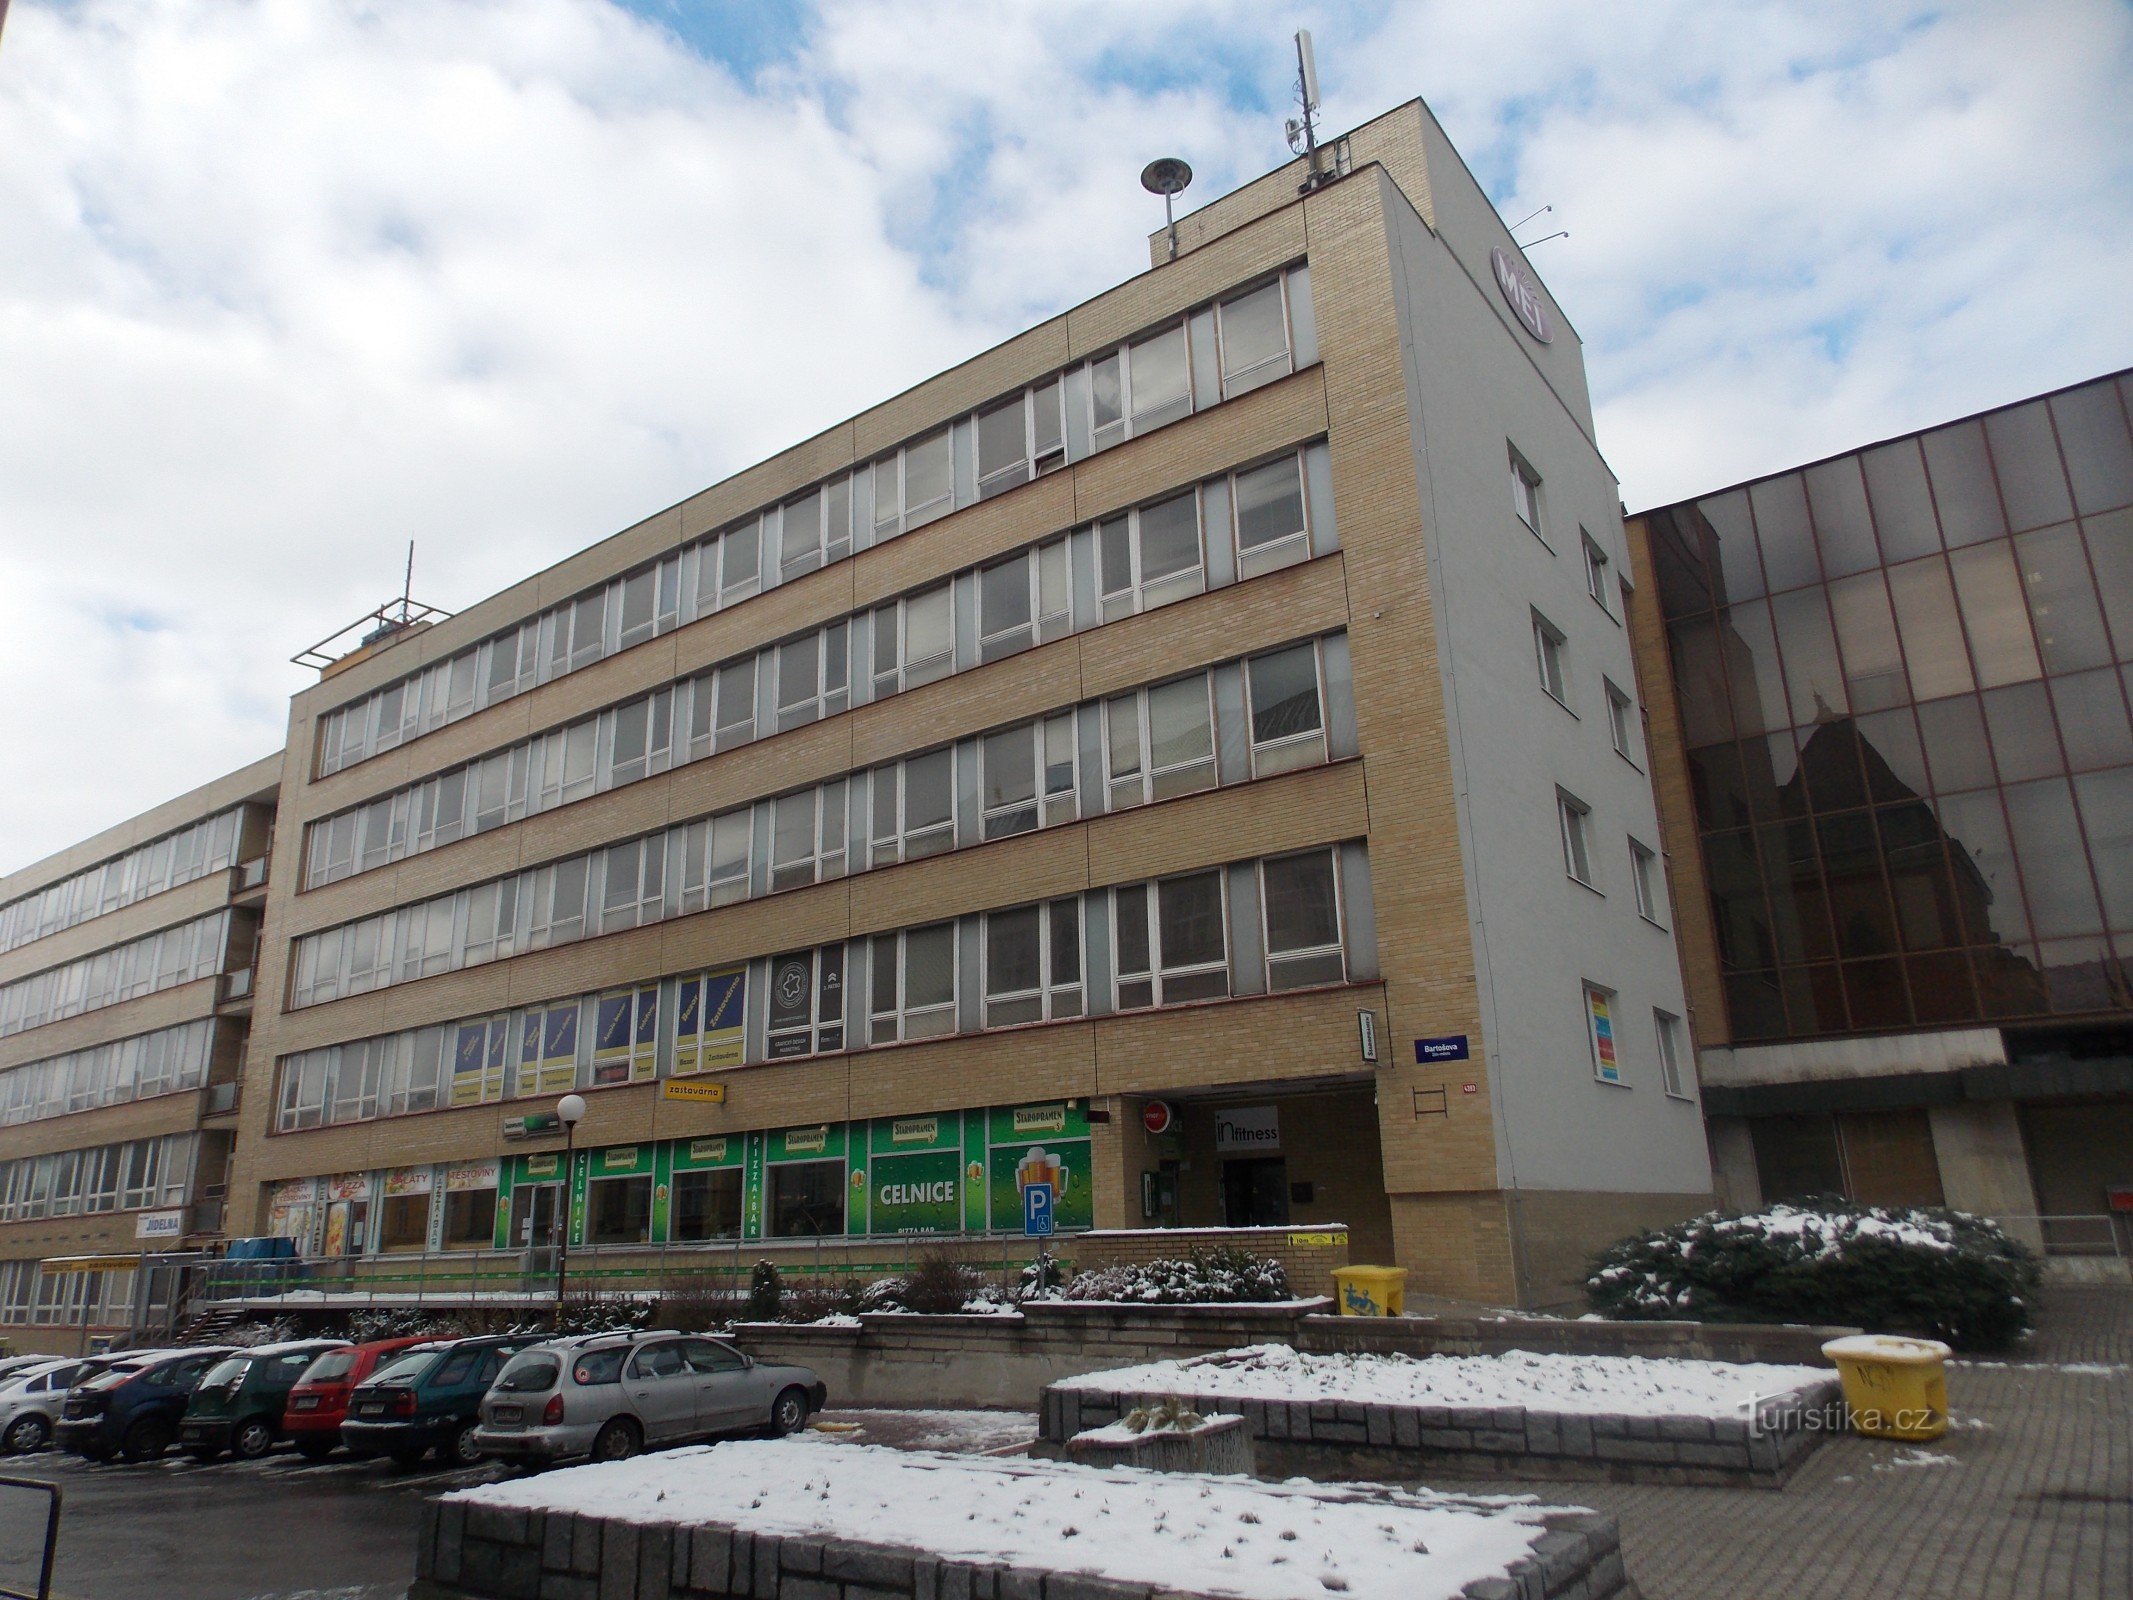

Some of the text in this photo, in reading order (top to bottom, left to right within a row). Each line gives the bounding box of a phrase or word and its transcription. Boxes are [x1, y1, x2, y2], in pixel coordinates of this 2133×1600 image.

[1424, 1043, 1458, 1053] Bartošova
[669, 1086, 719, 1097] zastavárna
[751, 1136, 759, 1193] PIZZA
[574, 1154, 585, 1243] CELNICE
[880, 1181, 954, 1206] CELNICE
[1030, 1190, 1047, 1220] P
